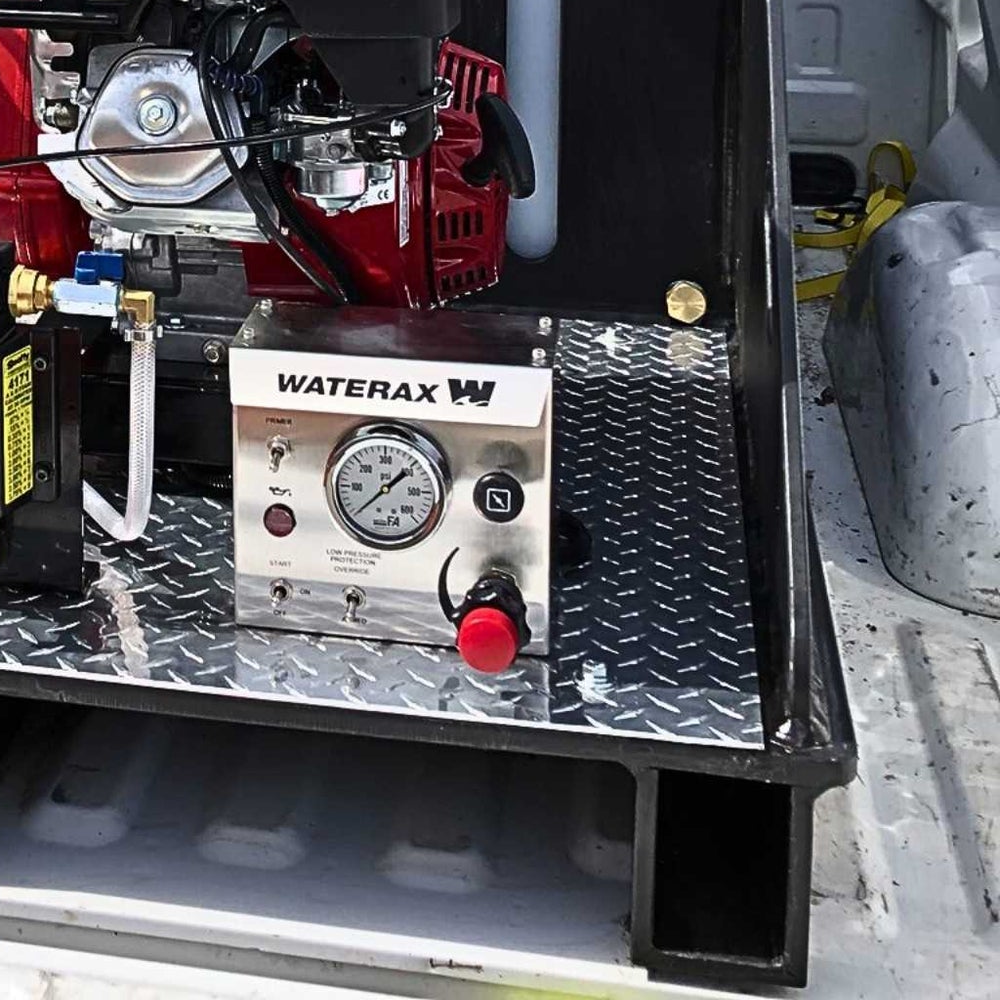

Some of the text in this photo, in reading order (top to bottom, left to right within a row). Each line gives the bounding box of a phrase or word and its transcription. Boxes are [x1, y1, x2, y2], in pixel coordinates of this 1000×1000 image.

[8, 370, 29, 390] 4171
[278, 373, 440, 404] WATERAX
[379, 455, 392, 465] 300
[359, 465, 373, 474] 200
[380, 472, 391, 481] psi
[351, 482, 363, 492] 100
[407, 487, 420, 496] 500
[401, 505, 414, 515] 600
[344, 549, 381, 559] PRESSURE
[330, 556, 376, 566] PROTECTION
